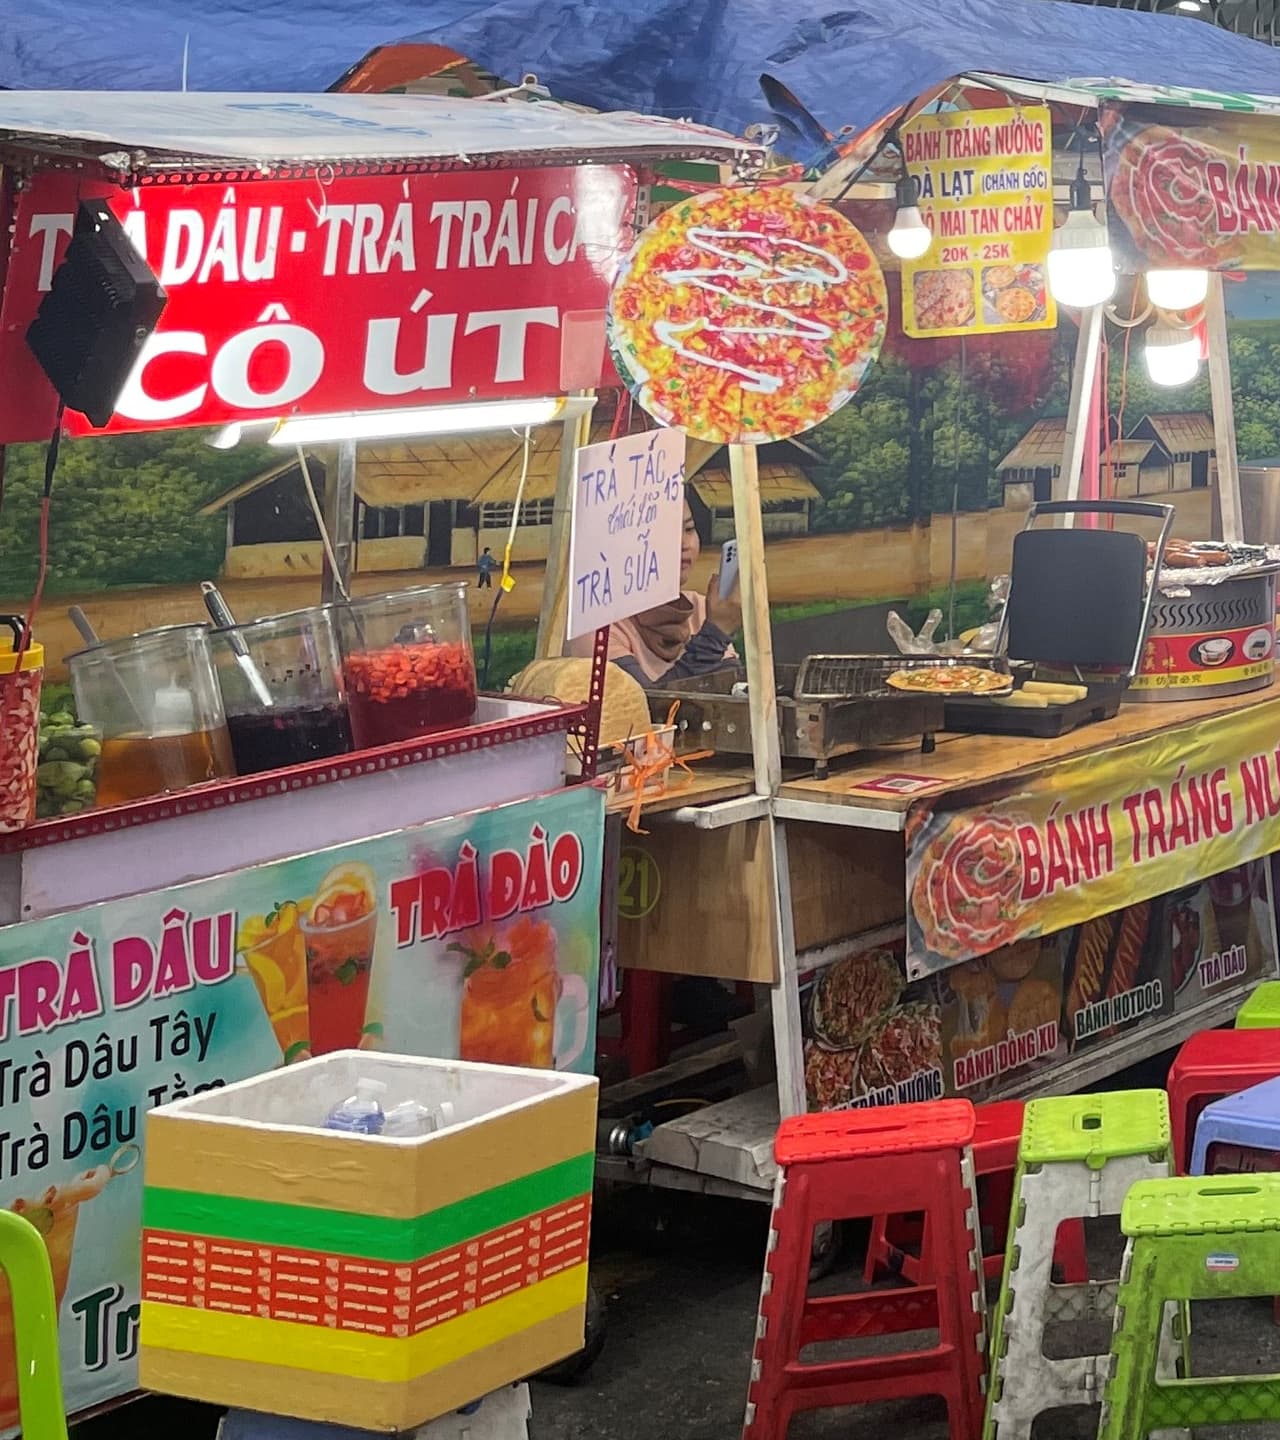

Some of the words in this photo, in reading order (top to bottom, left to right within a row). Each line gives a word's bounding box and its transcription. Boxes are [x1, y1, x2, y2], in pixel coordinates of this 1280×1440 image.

[906, 124, 941, 163] BÁNH
[940, 169, 975, 202] LẠT
[940, 210, 966, 237] MAI
[971, 207, 999, 234] TAN
[1003, 196, 1044, 232] CHẢY
[28, 187, 148, 292] TÀ
[160, 187, 284, 287] DÂU
[316, 177, 417, 276] TRÀ
[430, 176, 539, 270] TRÁI
[942, 247, 969, 263] 20K
[983, 244, 1010, 260] 25K
[113, 302, 326, 421] CÔ
[362, 288, 560, 396] ÚT
[577, 551, 613, 614] TRÀ
[1017, 800, 1115, 902] BÁNH
[1122, 764, 1234, 864] TRÁNG
[390, 838, 481, 948] TRÀ
[488, 821, 583, 922] ĐÀO
[619, 856, 649, 908] 21
[0, 930, 103, 1042] TRÀ
[111, 906, 237, 1011] DÂU
[1198, 951, 1223, 990] TRÀ
[1222, 944, 1247, 979] DÂU
[1074, 998, 1111, 1041] BÁNH
[1111, 979, 1163, 1025] HOTDOG
[0, 1049, 50, 1107] Trà
[64, 1032, 138, 1089] Dâu
[149, 1009, 217, 1063] Tây
[954, 1049, 998, 1091] BÁNH
[1037, 1021, 1058, 1054] XU
[62, 1103, 137, 1161] Dâu
